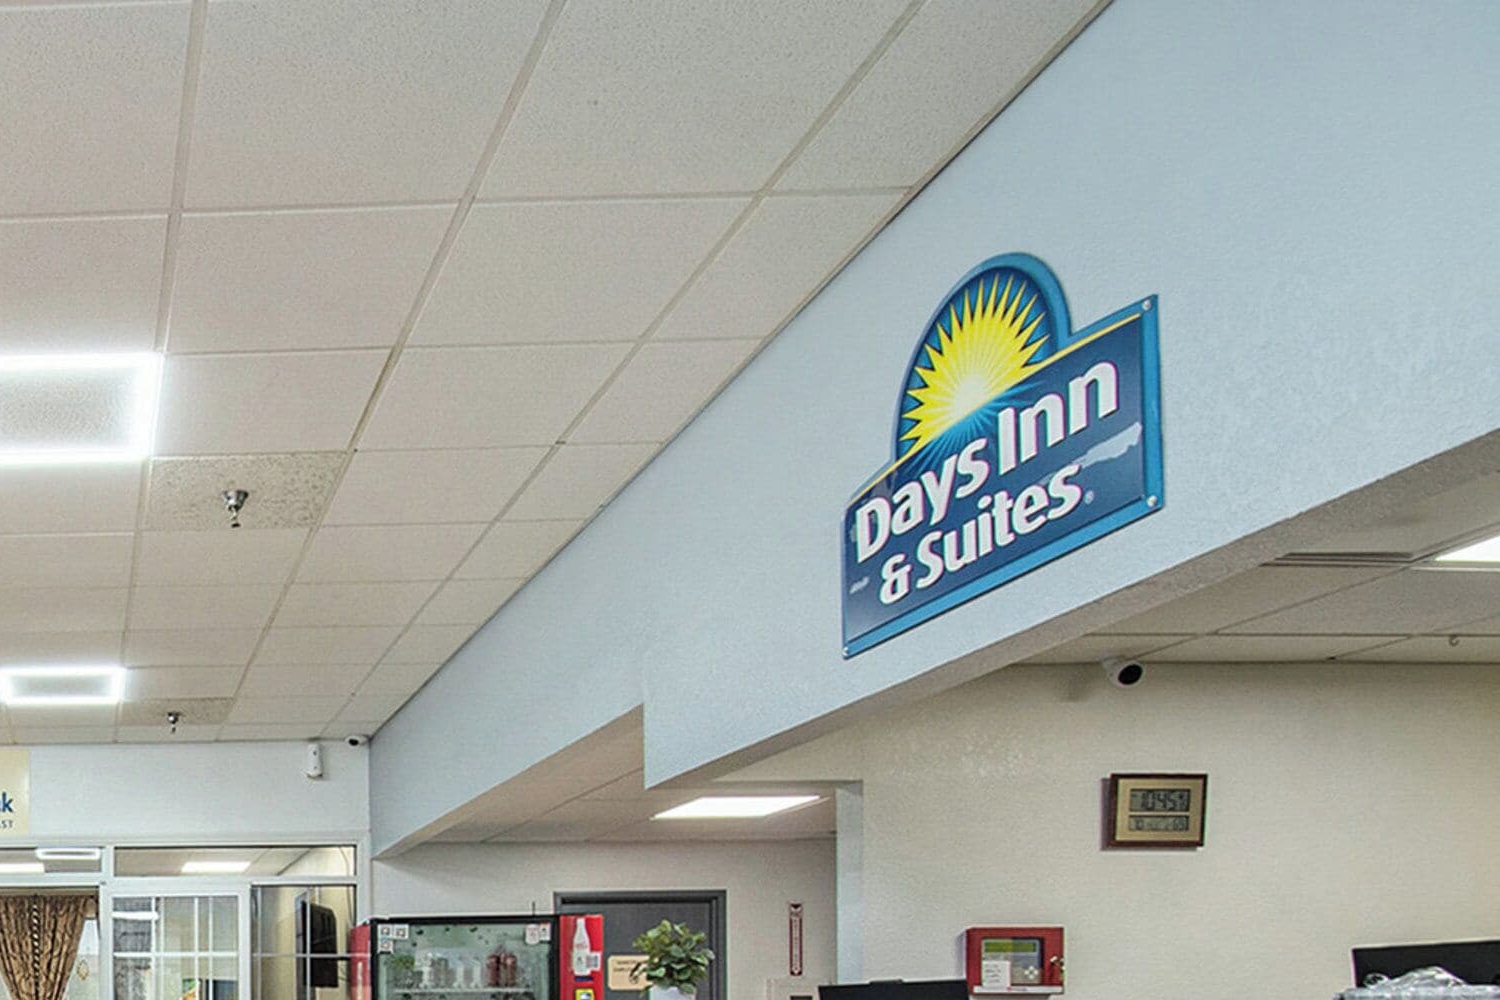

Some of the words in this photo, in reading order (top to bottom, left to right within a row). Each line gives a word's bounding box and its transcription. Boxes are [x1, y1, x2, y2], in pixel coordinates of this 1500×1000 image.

[855, 437, 990, 563] Days
[998, 361, 1118, 476] Inn
[879, 554, 912, 604] &
[915, 464, 1082, 588] Suites
